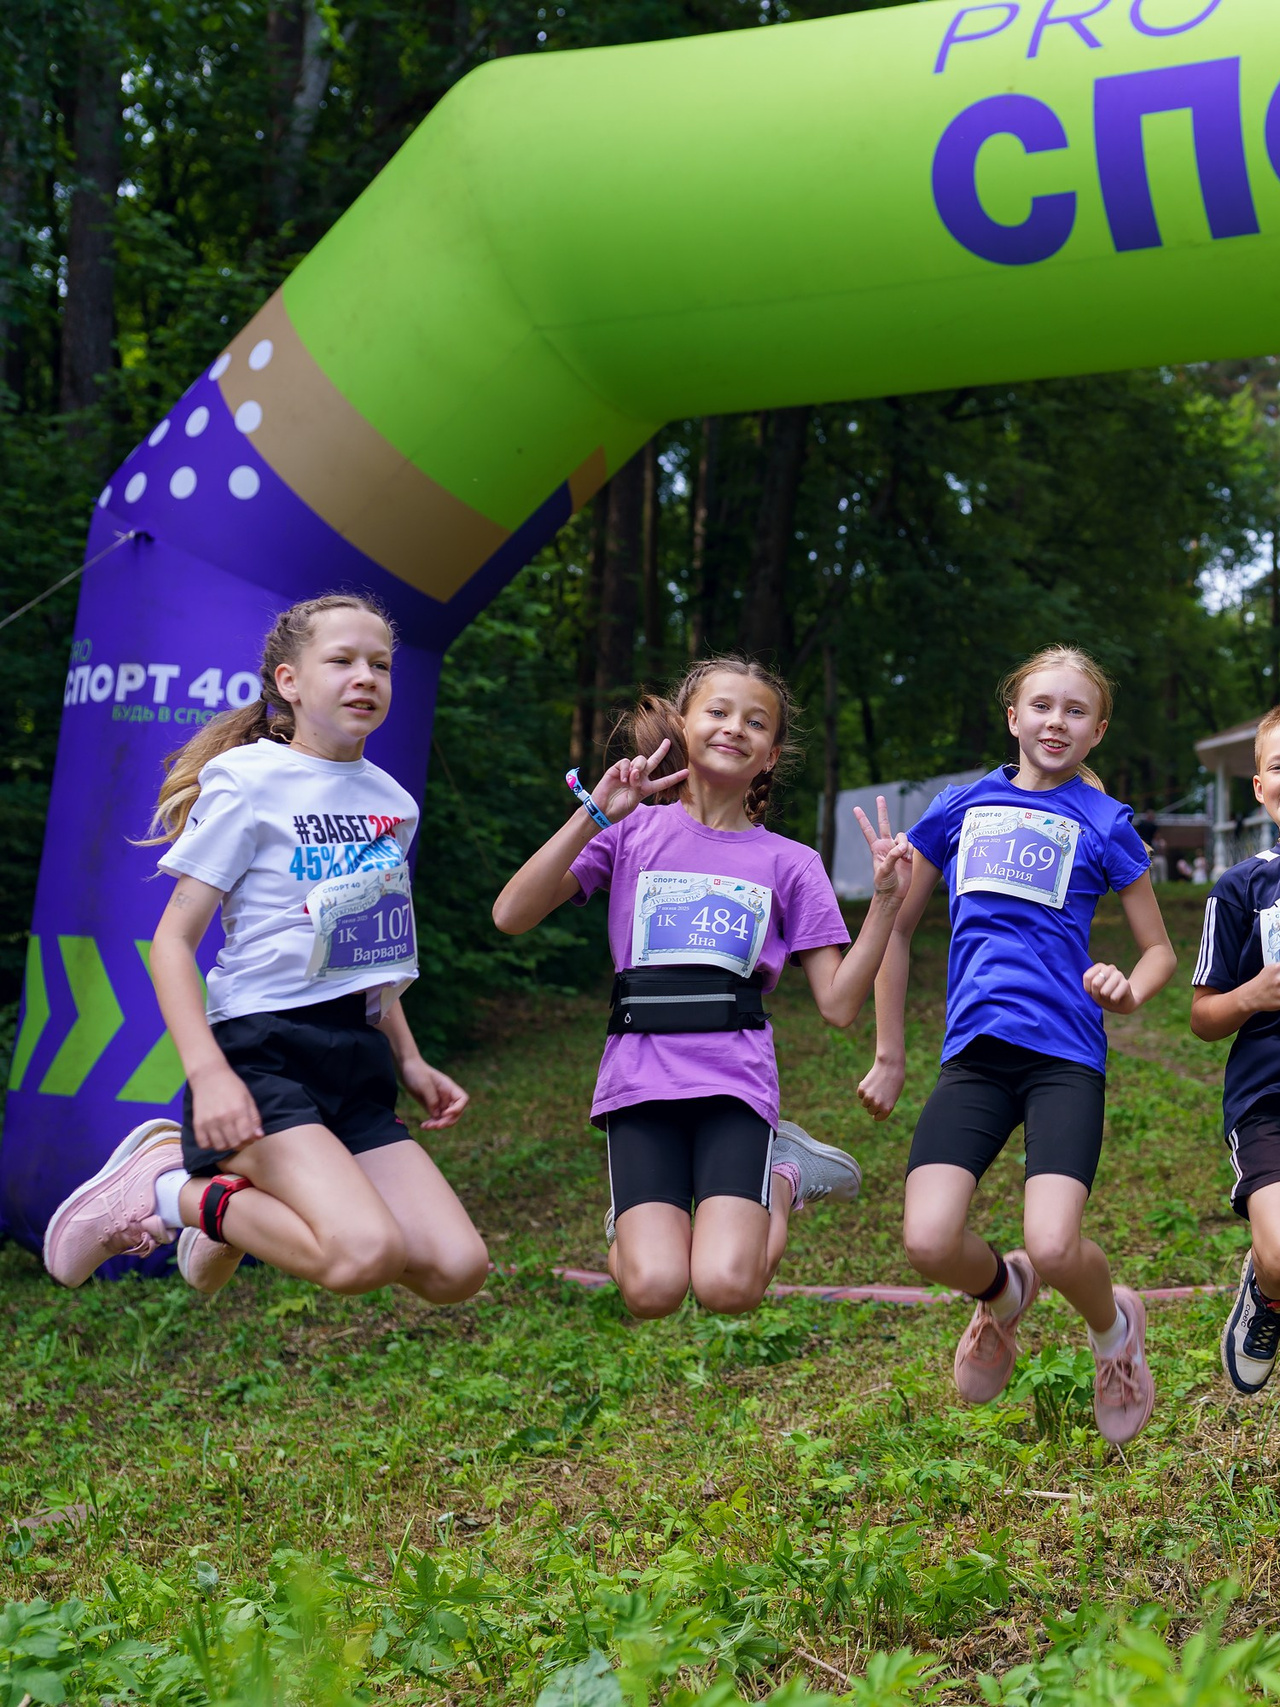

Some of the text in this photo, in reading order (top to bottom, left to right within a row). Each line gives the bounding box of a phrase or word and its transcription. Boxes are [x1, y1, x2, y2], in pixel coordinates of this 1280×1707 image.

[933, 0, 1221, 73] PRO
[63, 663, 263, 708] СПОРТ 40
[112, 704, 155, 723] БУДЬ
[158, 706, 171, 723] В
[293, 814, 406, 845] #ЗАБЕГ20
[289, 846, 342, 881] 45%
[1002, 838, 1055, 871] 169
[984, 862, 1034, 882] Мария
[322, 884, 349, 894] СПОРТ
[373, 903, 409, 943] 107
[691, 906, 749, 941] 484
[353, 943, 407, 965] Варвара
[686, 933, 716, 947] Яна
